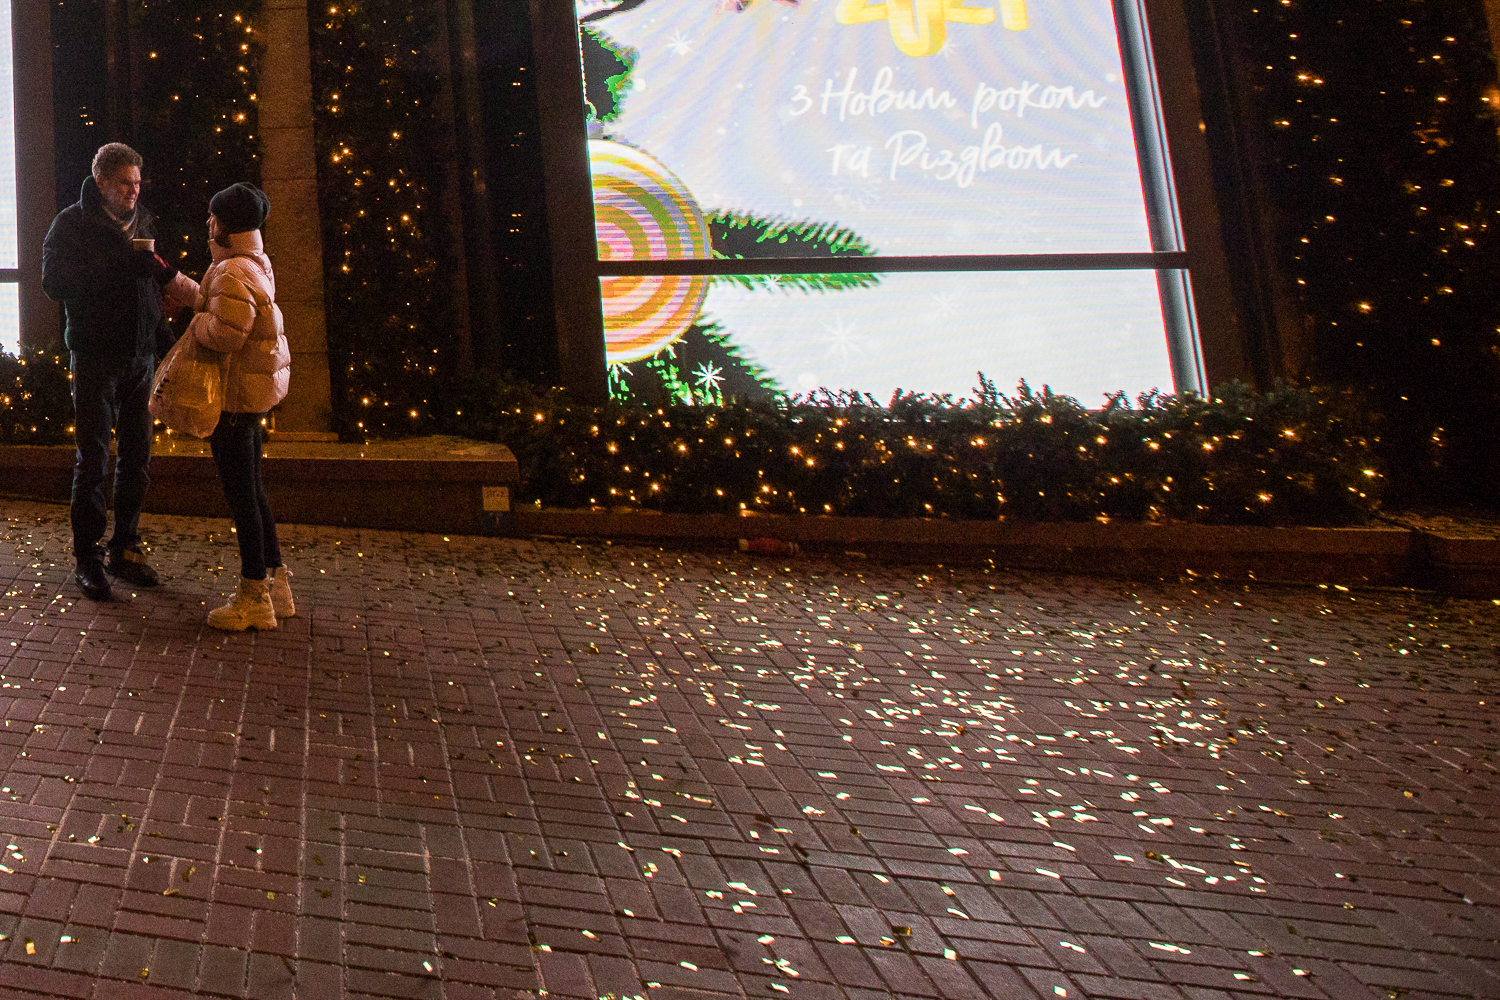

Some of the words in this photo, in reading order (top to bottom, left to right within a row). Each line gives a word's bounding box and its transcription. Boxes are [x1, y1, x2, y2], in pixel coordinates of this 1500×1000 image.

[788, 84, 813, 117] з
[820, 65, 957, 122] Новим
[971, 80, 1107, 129] роком
[825, 143, 873, 178] та
[884, 121, 1079, 189] Різдвом
